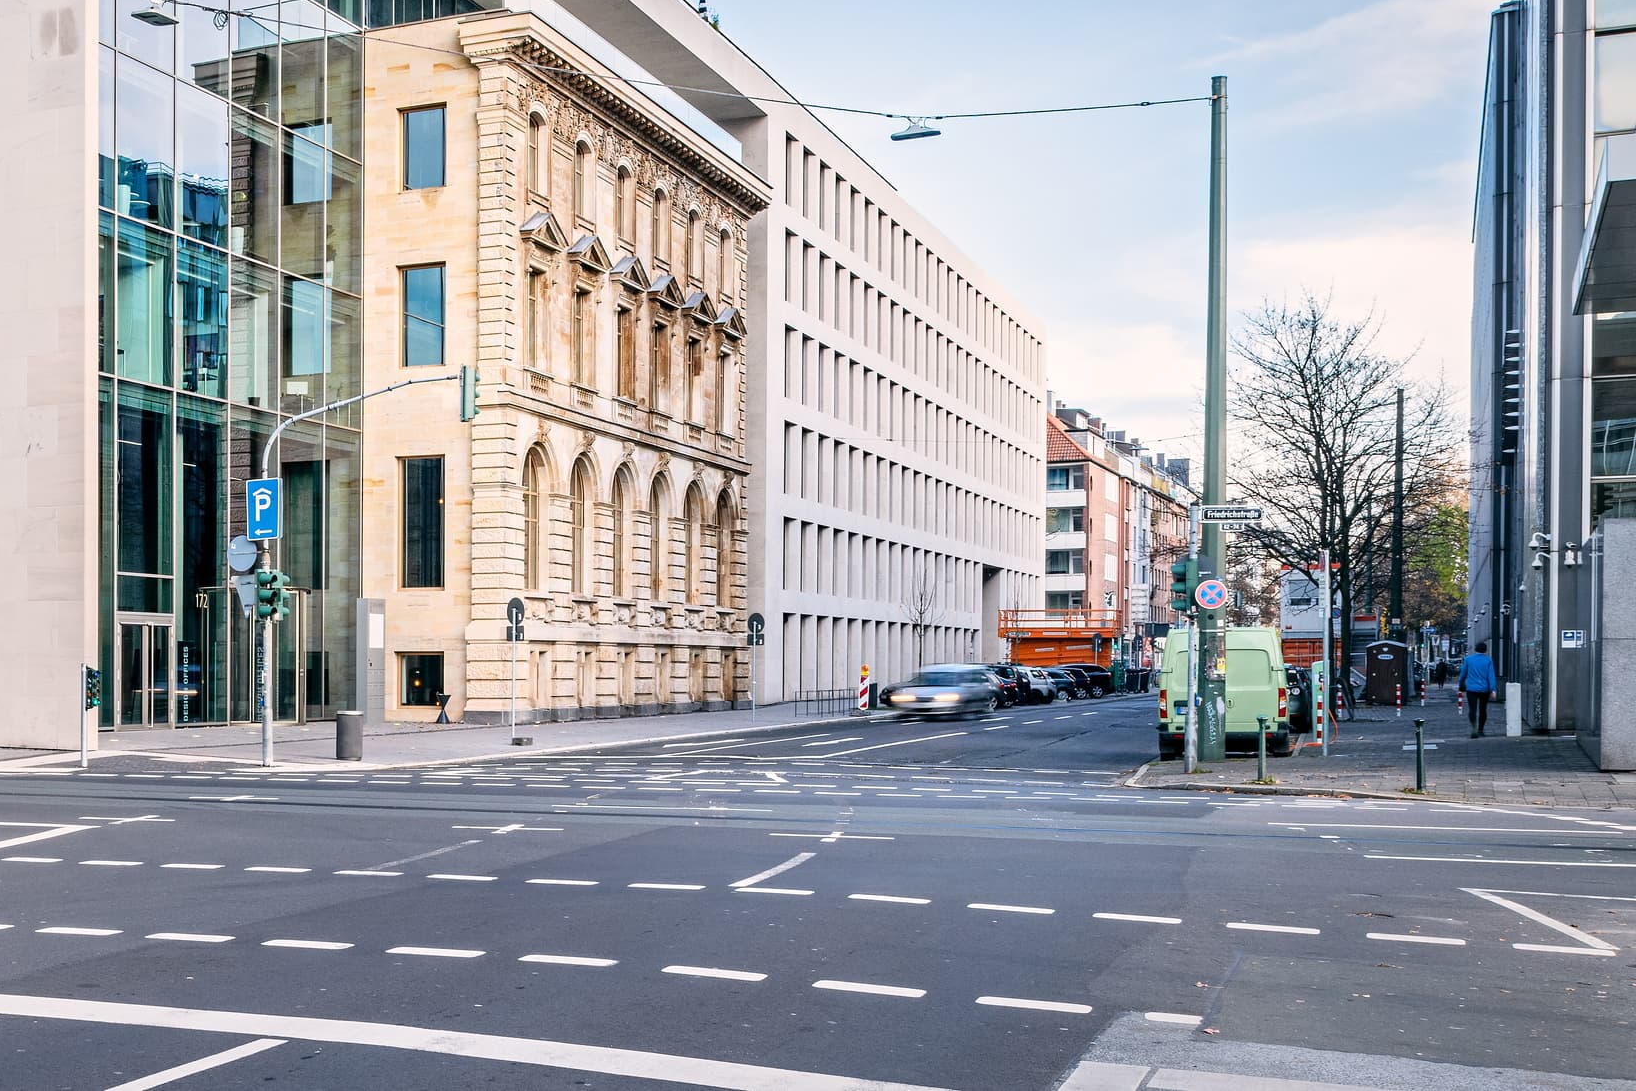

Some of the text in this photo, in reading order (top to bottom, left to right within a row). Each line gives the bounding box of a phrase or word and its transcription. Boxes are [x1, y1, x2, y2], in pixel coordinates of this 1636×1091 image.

[255, 494, 271, 522] P
[1207, 510, 1259, 519] Friedrichstraße
[196, 593, 208, 609] 172
